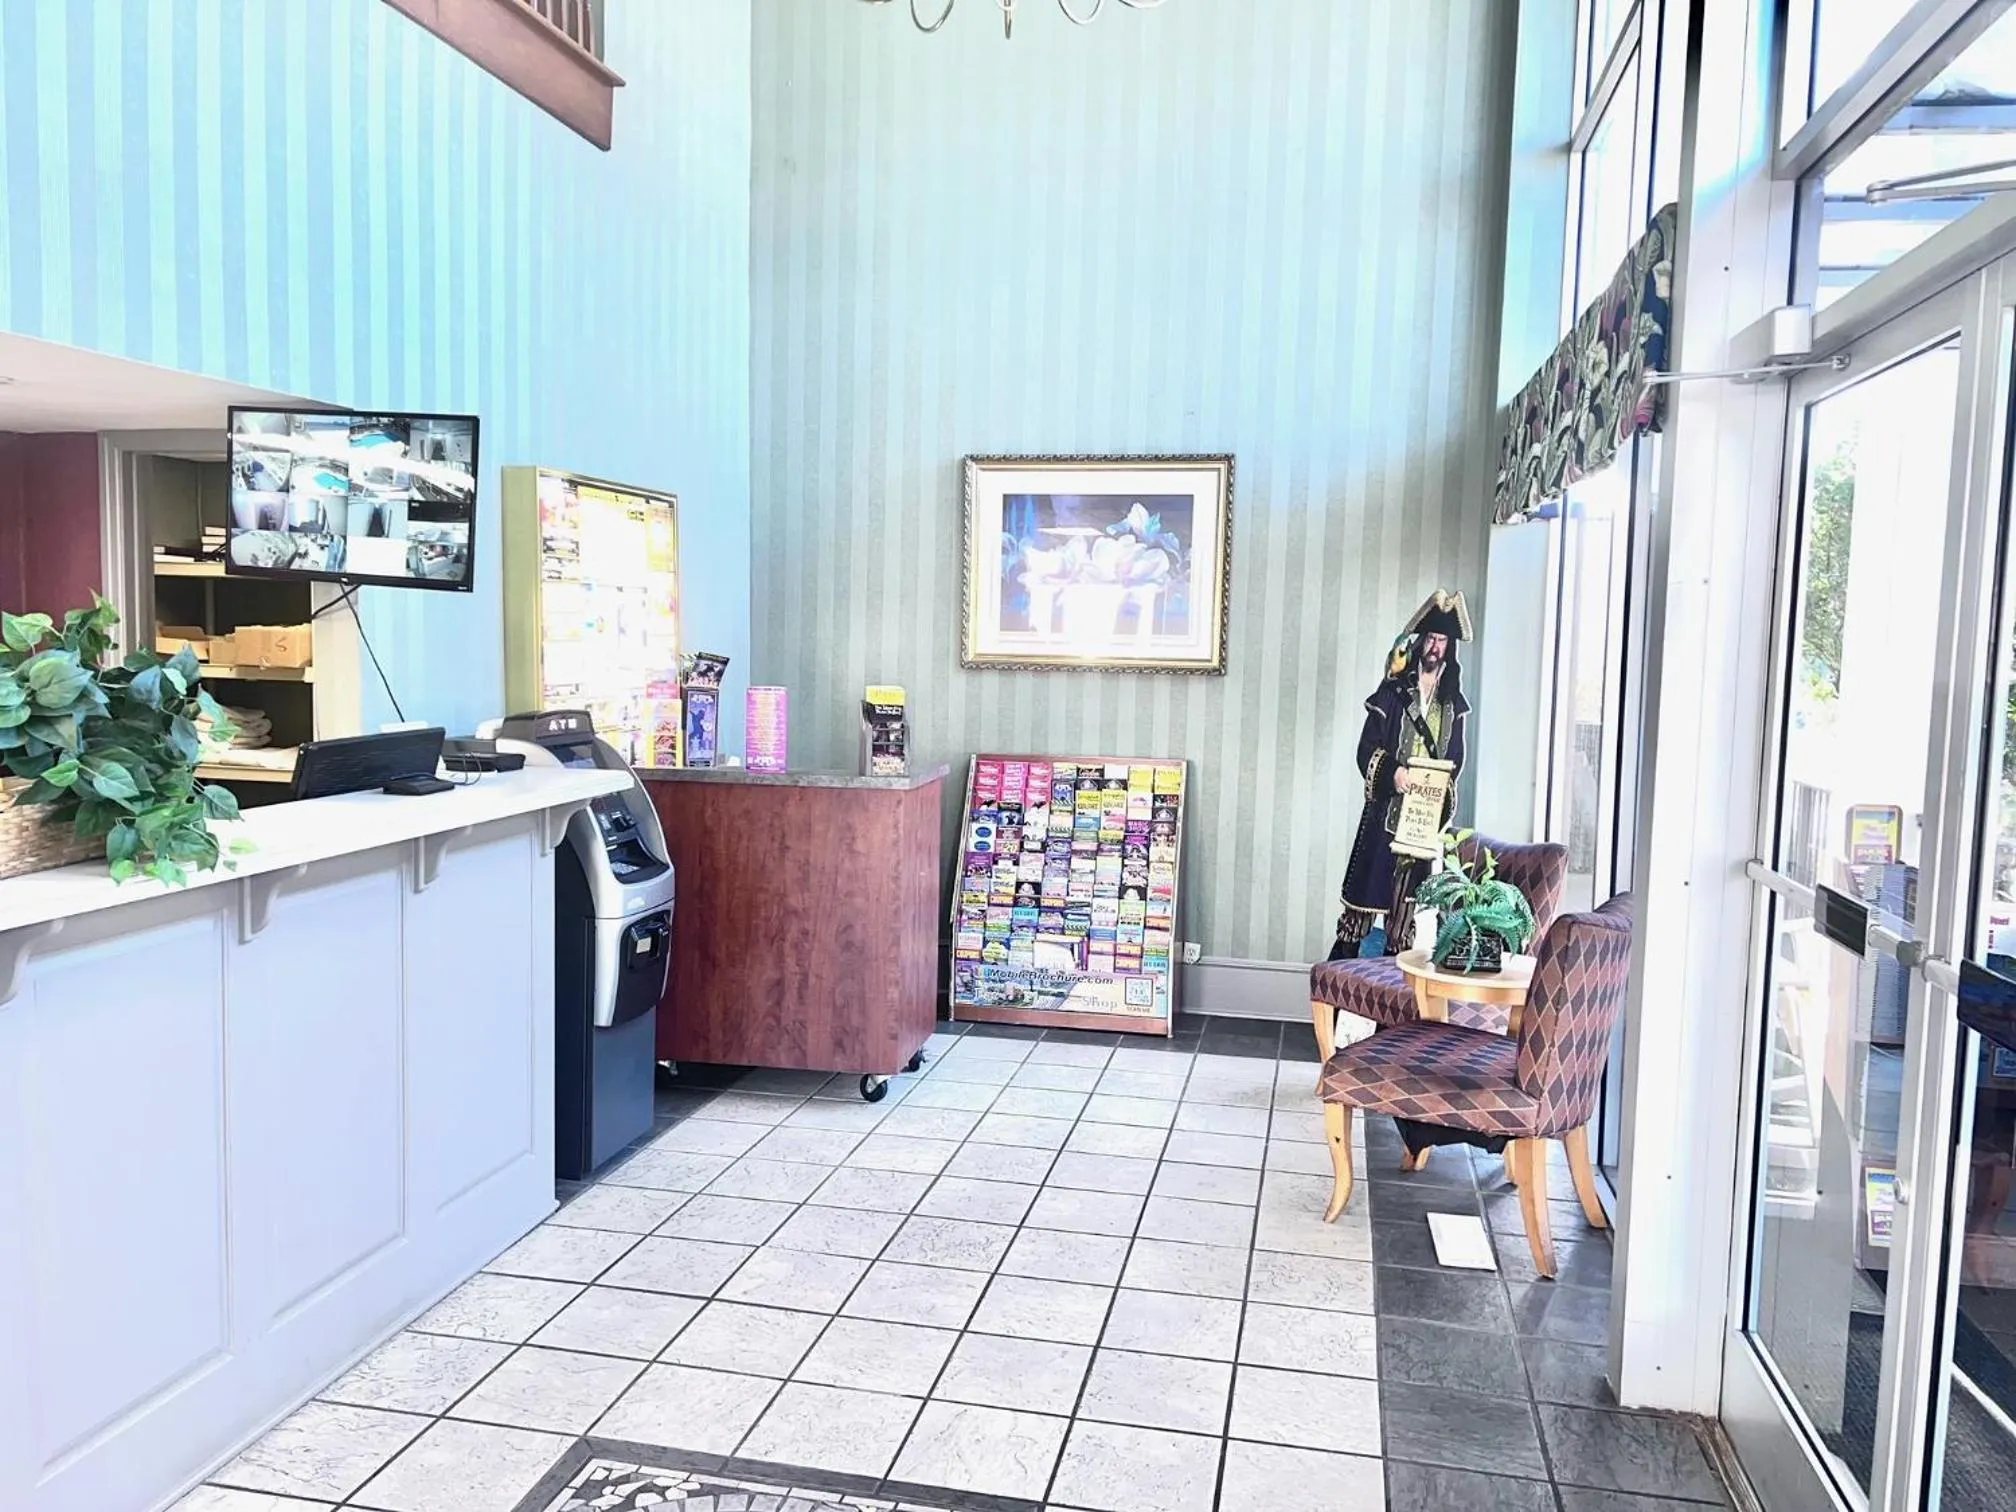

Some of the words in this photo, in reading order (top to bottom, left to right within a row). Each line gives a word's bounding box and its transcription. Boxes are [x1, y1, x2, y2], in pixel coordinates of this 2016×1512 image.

[548, 718, 577, 731] ATM
[1409, 783, 1443, 798] PIRATES
[990, 968, 1114, 986] MobileBrochure.com
